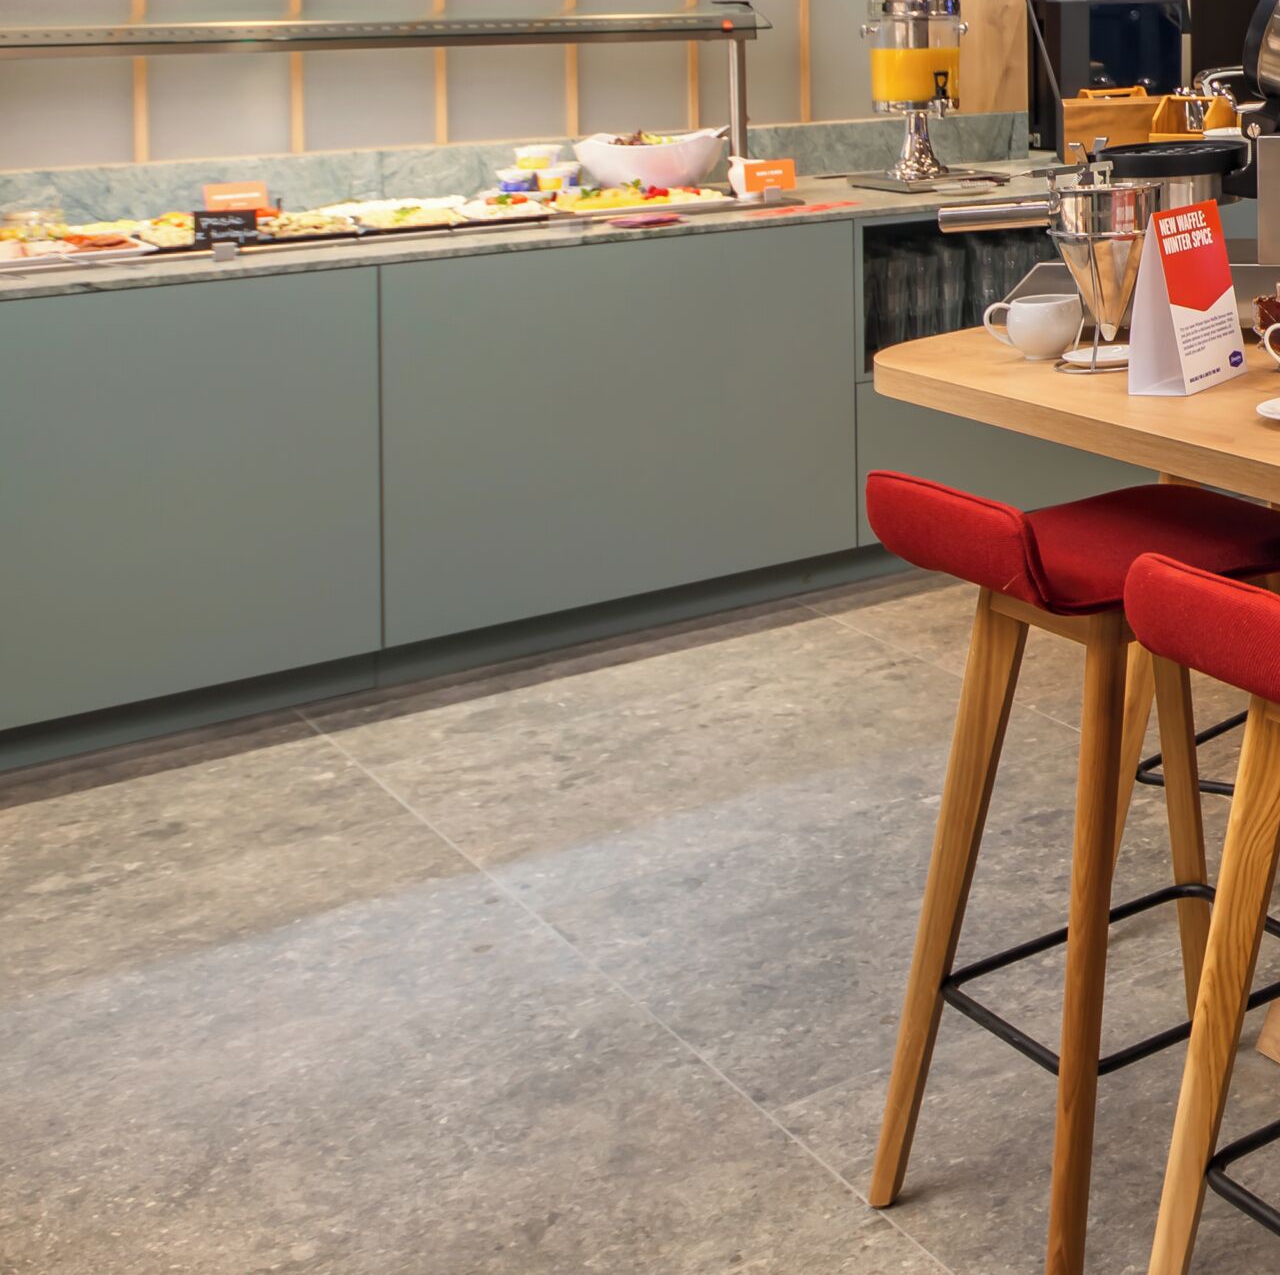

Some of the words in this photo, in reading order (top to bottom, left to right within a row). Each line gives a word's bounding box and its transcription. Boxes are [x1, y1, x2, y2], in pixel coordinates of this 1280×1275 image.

[1159, 216, 1177, 236] NEW
[1162, 233, 1192, 255] WINTER
[1191, 227, 1213, 248] SPICE
